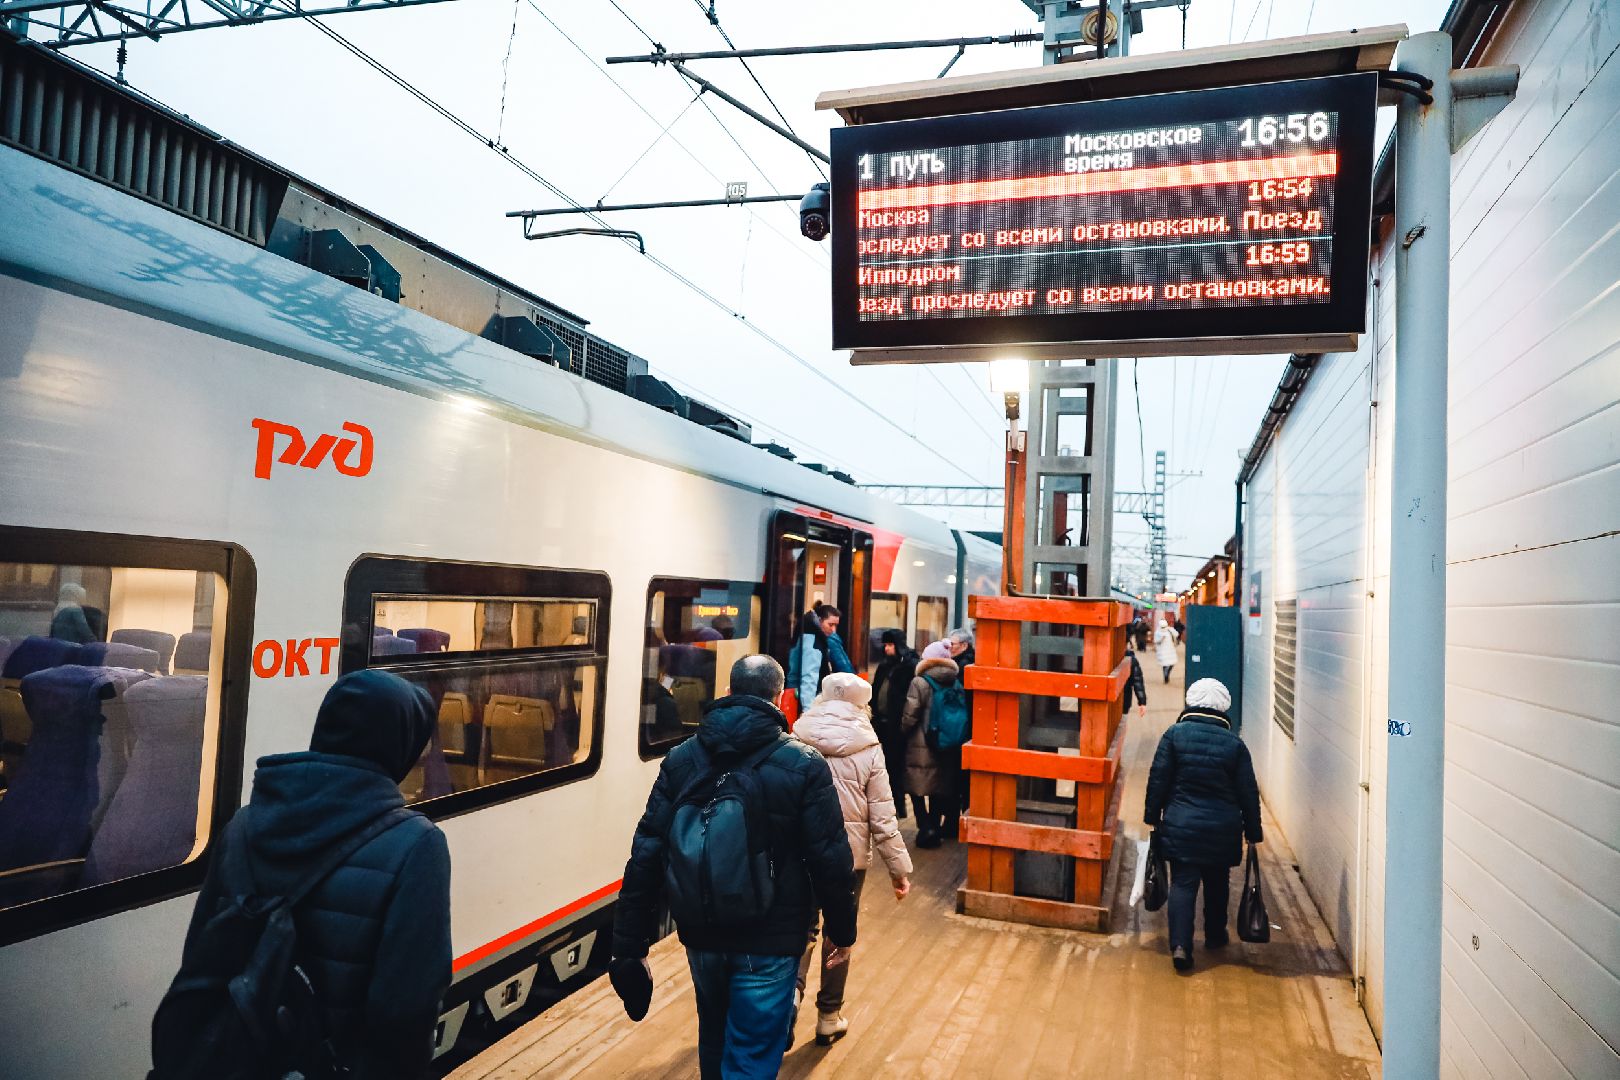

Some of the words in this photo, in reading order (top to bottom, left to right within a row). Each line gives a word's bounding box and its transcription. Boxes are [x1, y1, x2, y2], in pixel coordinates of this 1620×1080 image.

[1064, 127, 1202, 154] Московское
[1238, 113, 1328, 147] 16:56
[858, 153, 873, 179] 1
[890, 152, 946, 180] путь
[1064, 152, 1134, 173] время
[858, 209, 929, 228] Москва
[1248, 178, 1312, 201] 16:54
[961, 231, 985, 248] со
[997, 226, 1063, 246] всеми
[1073, 216, 1231, 241] остановками.
[1243, 210, 1322, 231] Поезд
[858, 265, 960, 287] Ипподром
[1246, 243, 1310, 265] 16:59
[913, 290, 1036, 313] проследует
[1046, 288, 1072, 304] со
[1083, 285, 1153, 302] всеми
[1164, 277, 1331, 299] остановками.
[252, 637, 340, 678] ОКТ
